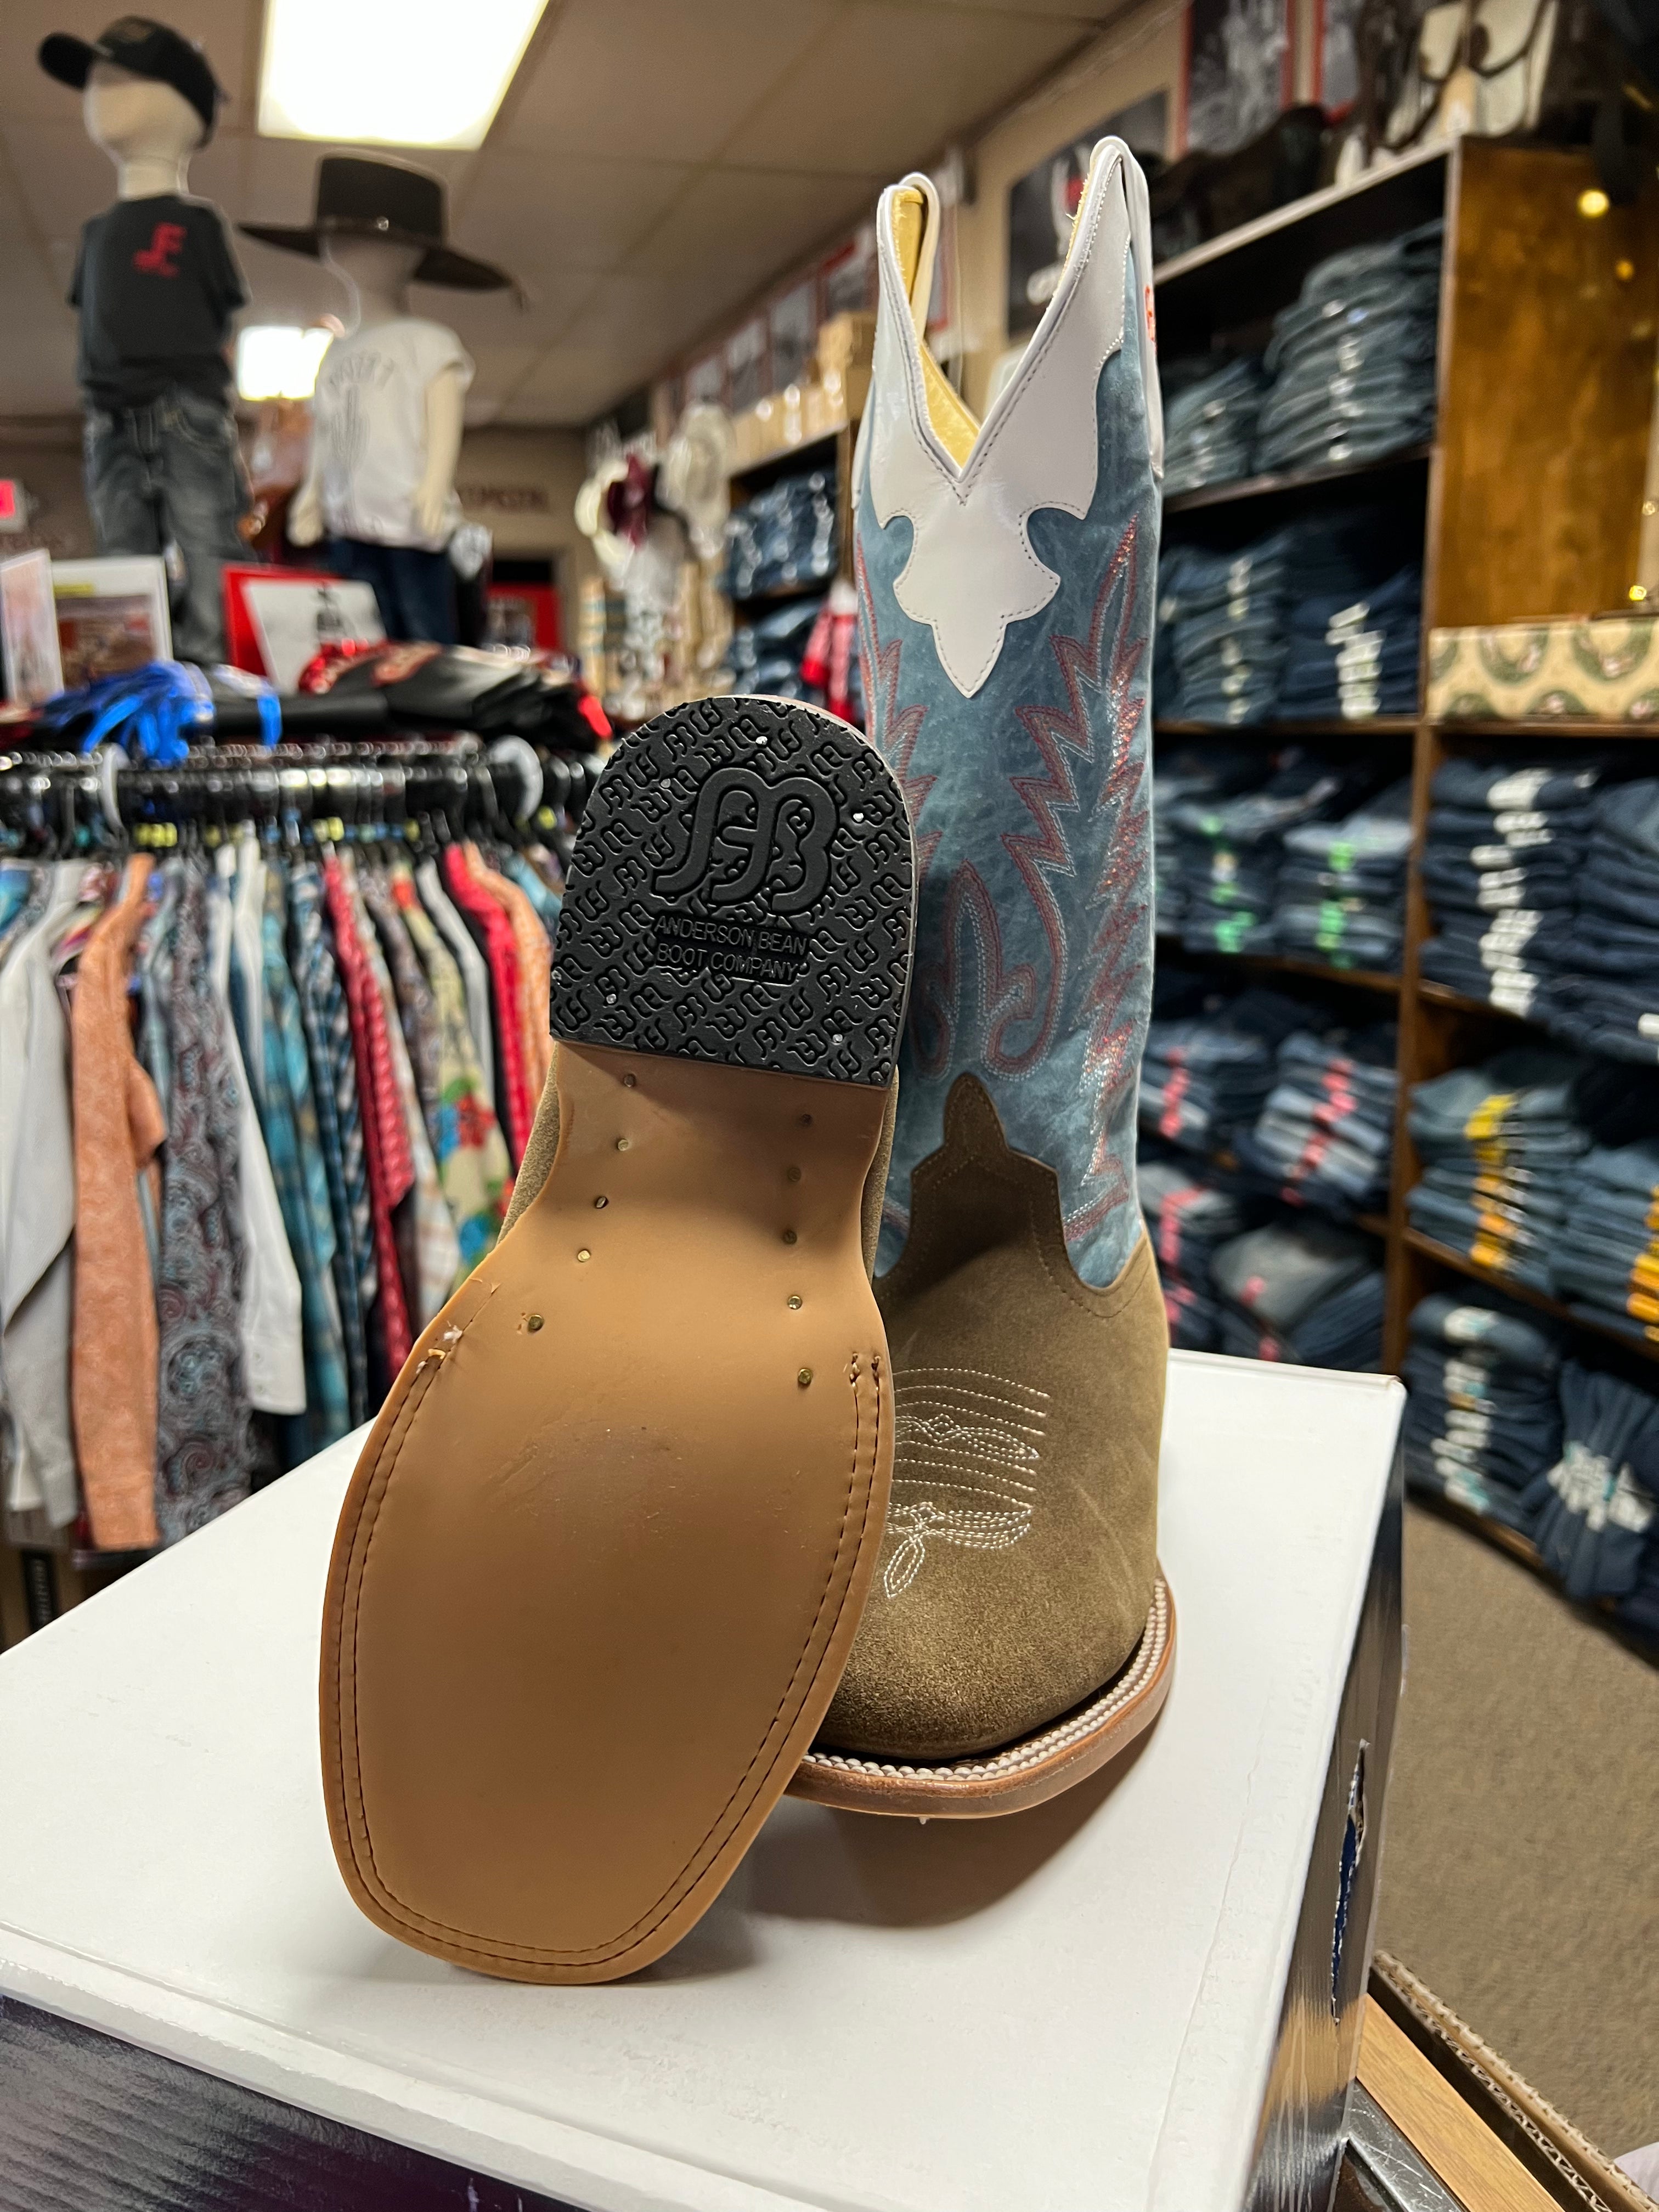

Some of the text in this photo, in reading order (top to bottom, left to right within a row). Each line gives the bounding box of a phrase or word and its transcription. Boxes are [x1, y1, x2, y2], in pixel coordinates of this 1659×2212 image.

[654, 915, 807, 955] ANDERSON BEAN
[657, 943, 799, 981] BOOT COMPANY
